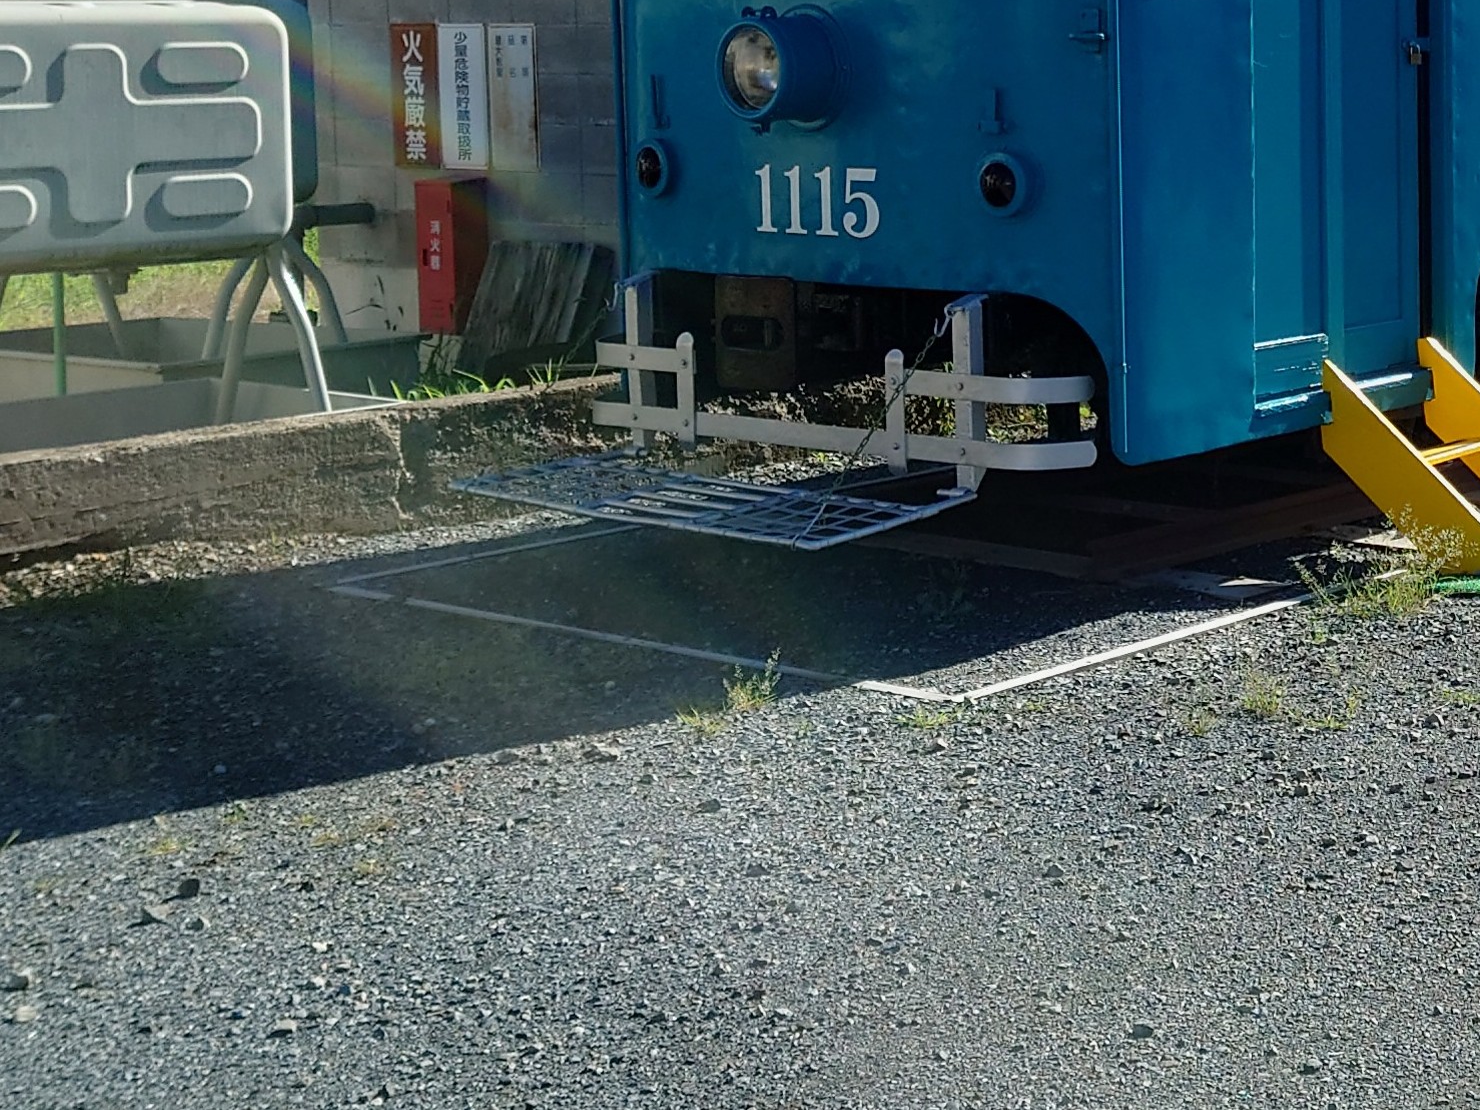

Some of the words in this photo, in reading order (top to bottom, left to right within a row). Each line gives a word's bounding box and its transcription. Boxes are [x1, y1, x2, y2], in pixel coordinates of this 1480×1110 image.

[401, 30, 427, 161] 火気厳禁
[453, 31, 472, 161] 少量危険物貯蔵取扱所
[754, 163, 881, 239] 1115
